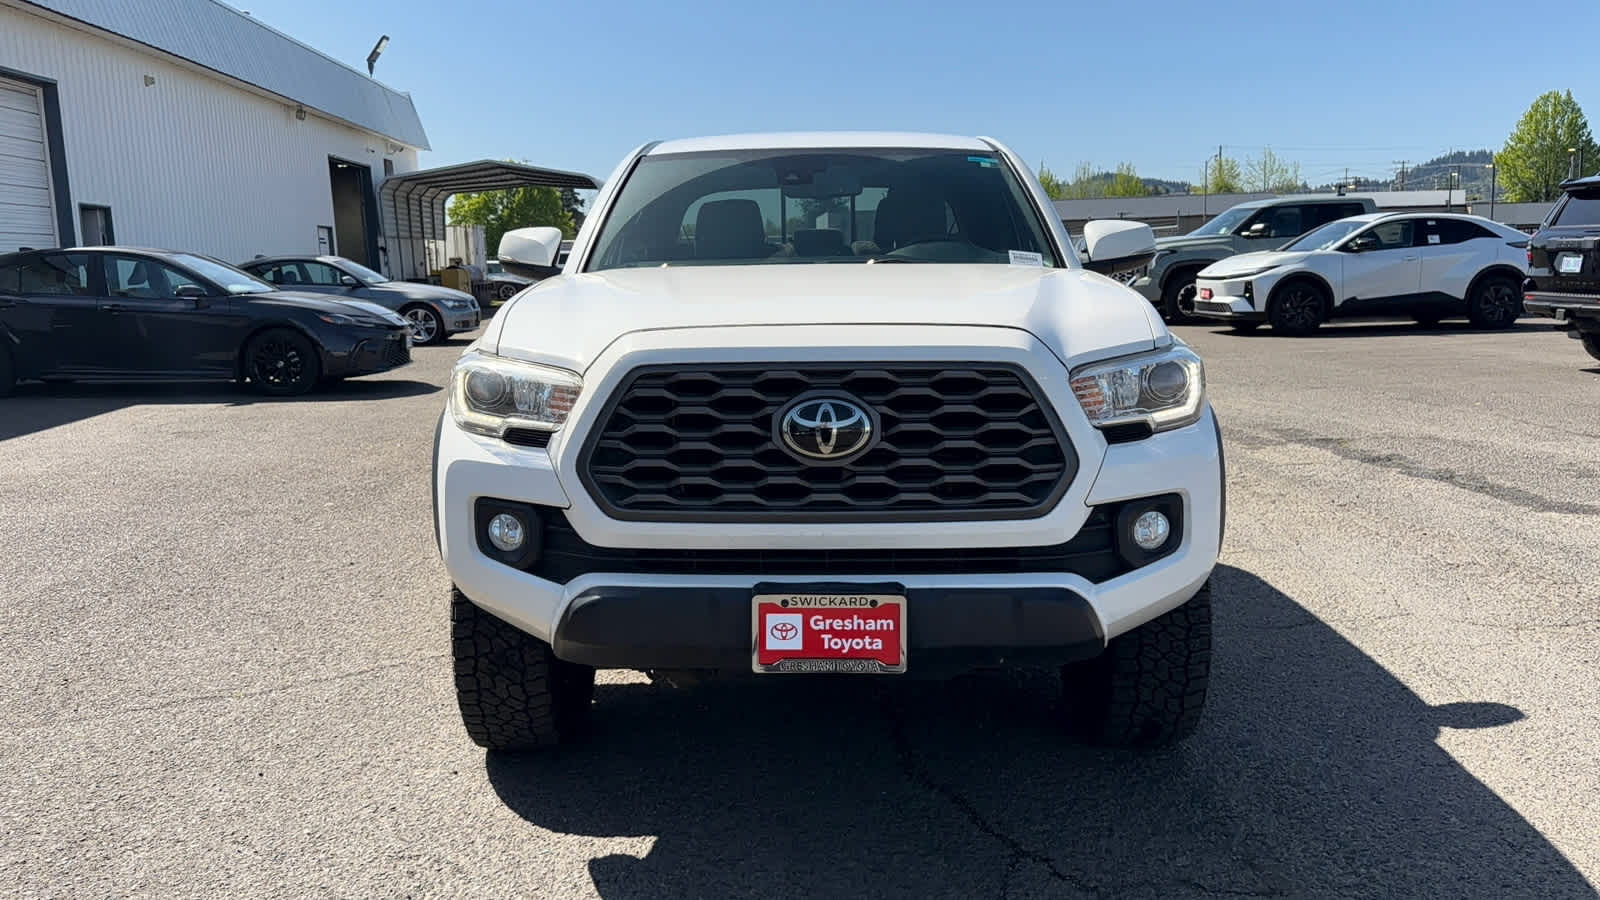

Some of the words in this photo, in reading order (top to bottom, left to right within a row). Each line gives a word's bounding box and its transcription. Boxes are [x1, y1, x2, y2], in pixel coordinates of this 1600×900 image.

[790, 596, 868, 607] SWICKARD
[810, 615, 894, 631] Gresham
[821, 634, 882, 653] Toyota
